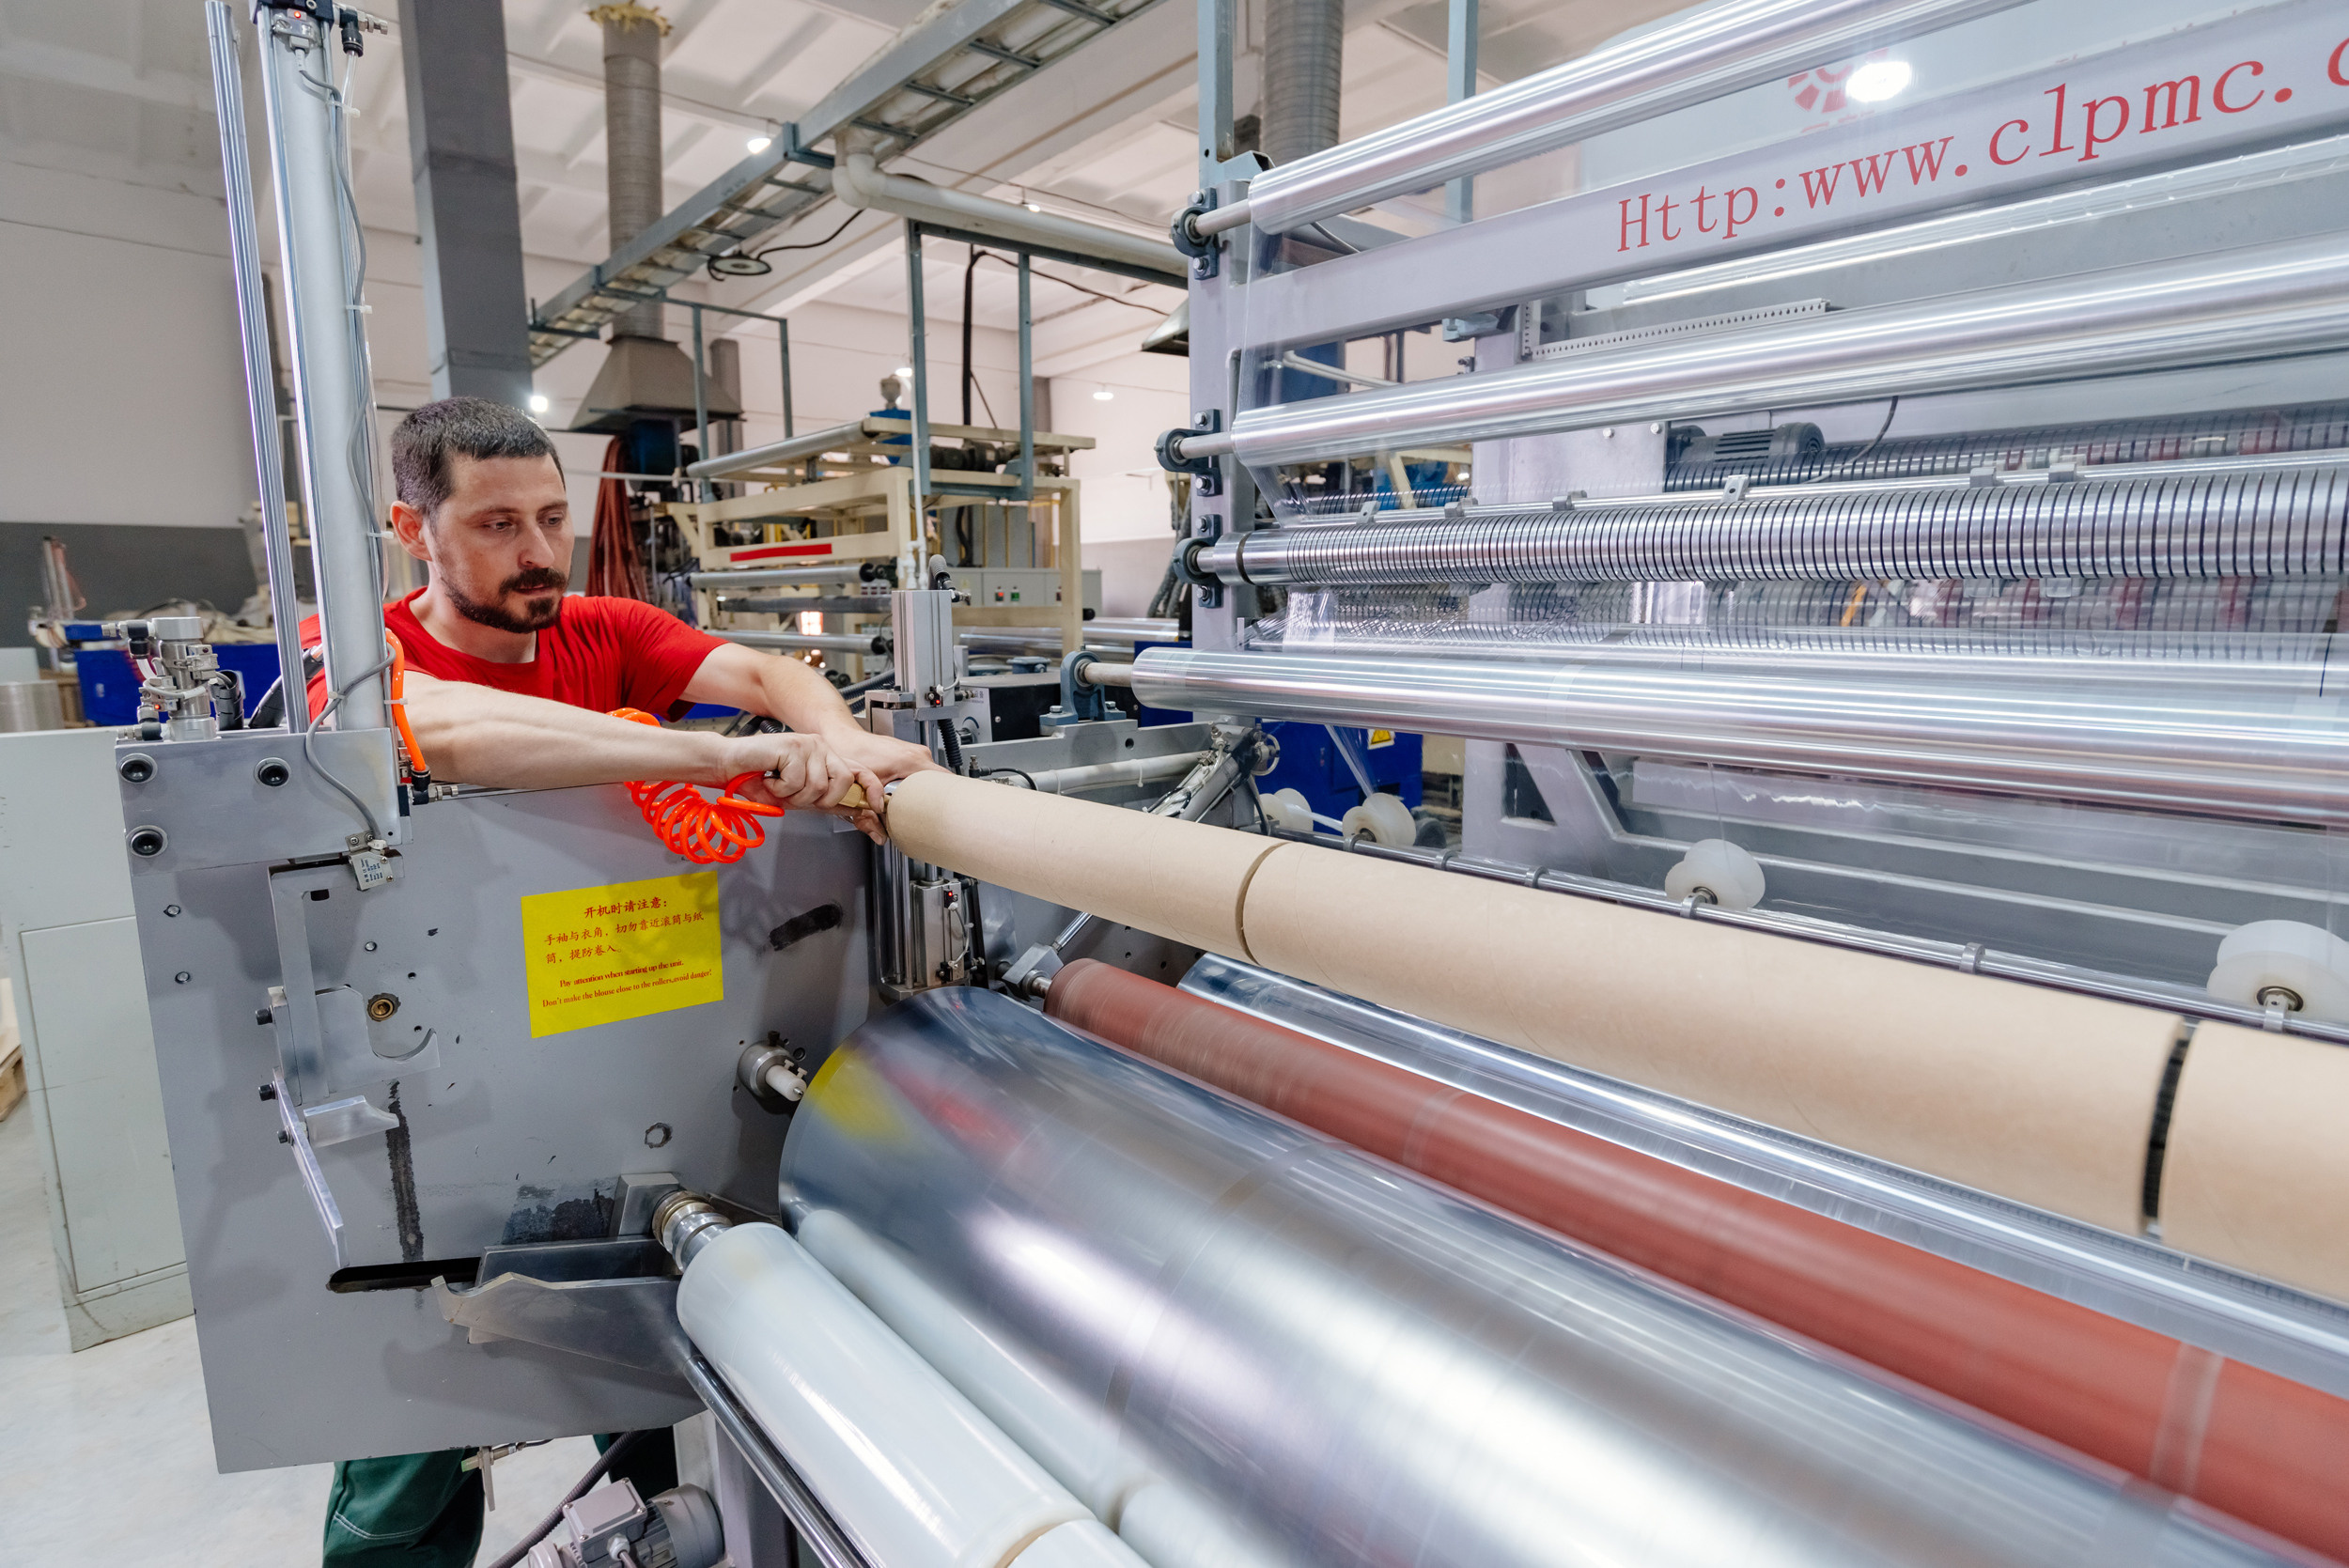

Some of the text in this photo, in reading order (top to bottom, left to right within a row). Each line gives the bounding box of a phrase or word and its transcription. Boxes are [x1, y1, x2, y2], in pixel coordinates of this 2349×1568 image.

[574, 974, 603, 986] attention
[625, 967, 647, 976] starting
[542, 997, 562, 1007] Don't
[564, 995, 581, 1004] make
[595, 989, 614, 998] blouse
[616, 986, 631, 994] close
